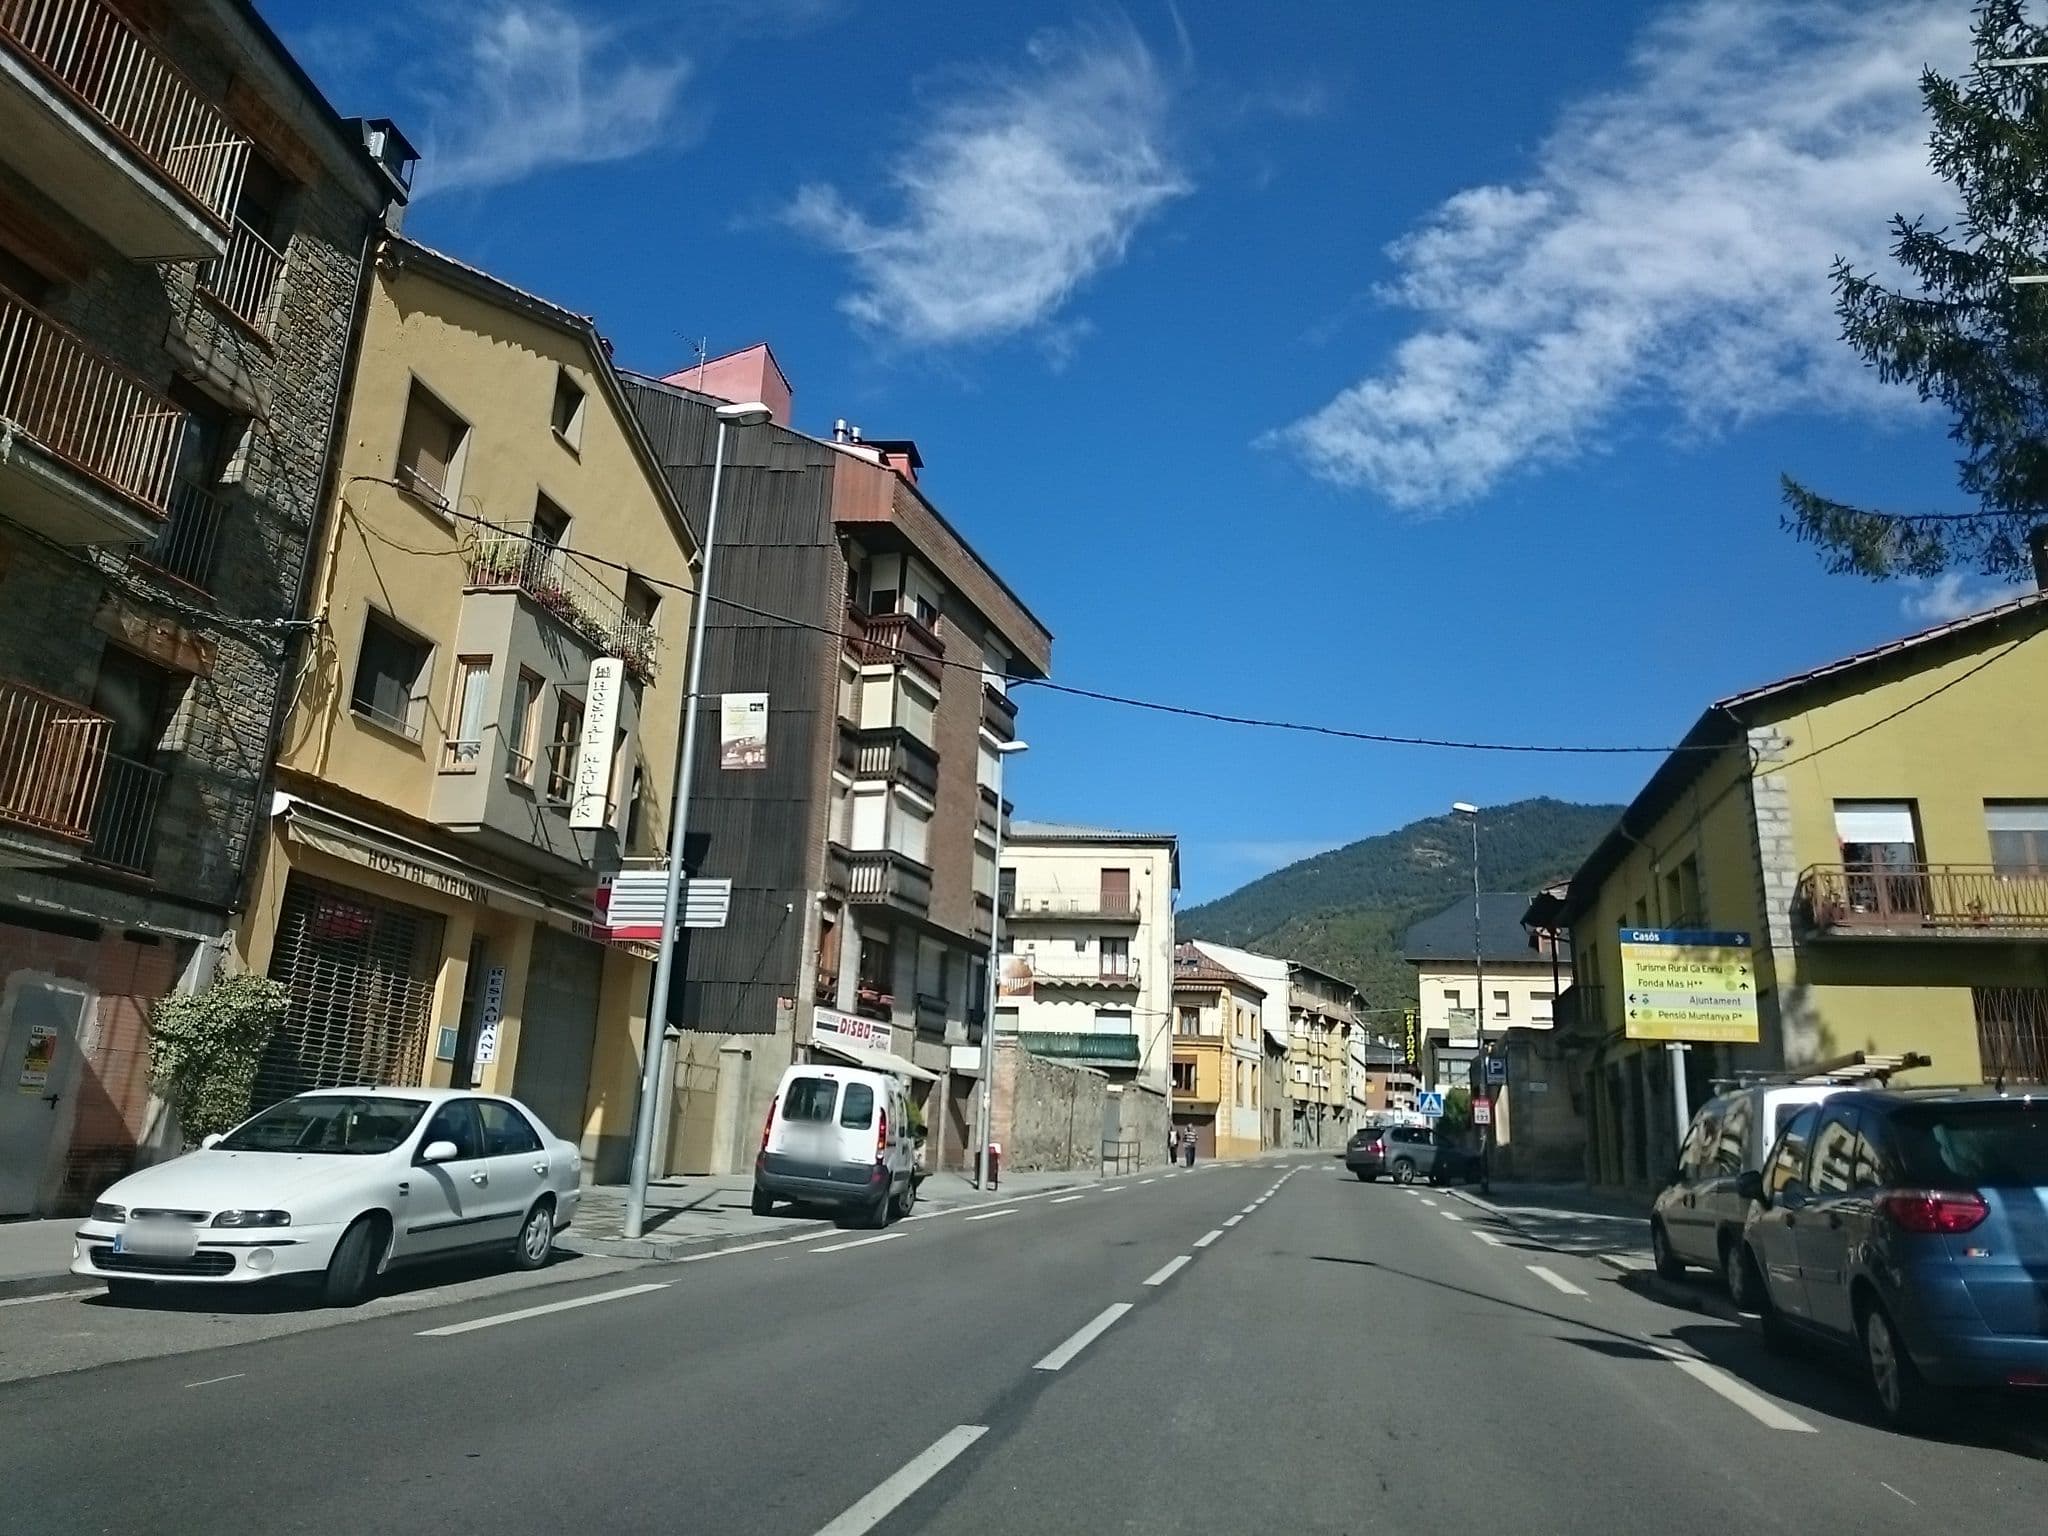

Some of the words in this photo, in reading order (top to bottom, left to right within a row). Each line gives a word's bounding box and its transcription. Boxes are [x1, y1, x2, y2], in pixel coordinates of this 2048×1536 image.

[588, 681, 609, 745] HOSTAL
[367, 848, 428, 885] HOSTAL
[437, 874, 489, 905] MAURIN
[571, 920, 590, 938] BAR
[1632, 930, 1660, 942] Casós
[1636, 963, 1667, 972] Turisme
[1668, 963, 1689, 973] Rural
[1638, 979, 1664, 987] Fonda
[1667, 980, 1684, 988] Mas
[1689, 996, 1742, 1006] Ajuntament
[481, 969, 504, 1059] RESTAURANT
[1658, 1009, 1687, 1019] Pensió
[1688, 1011, 1730, 1021] Muntanya
